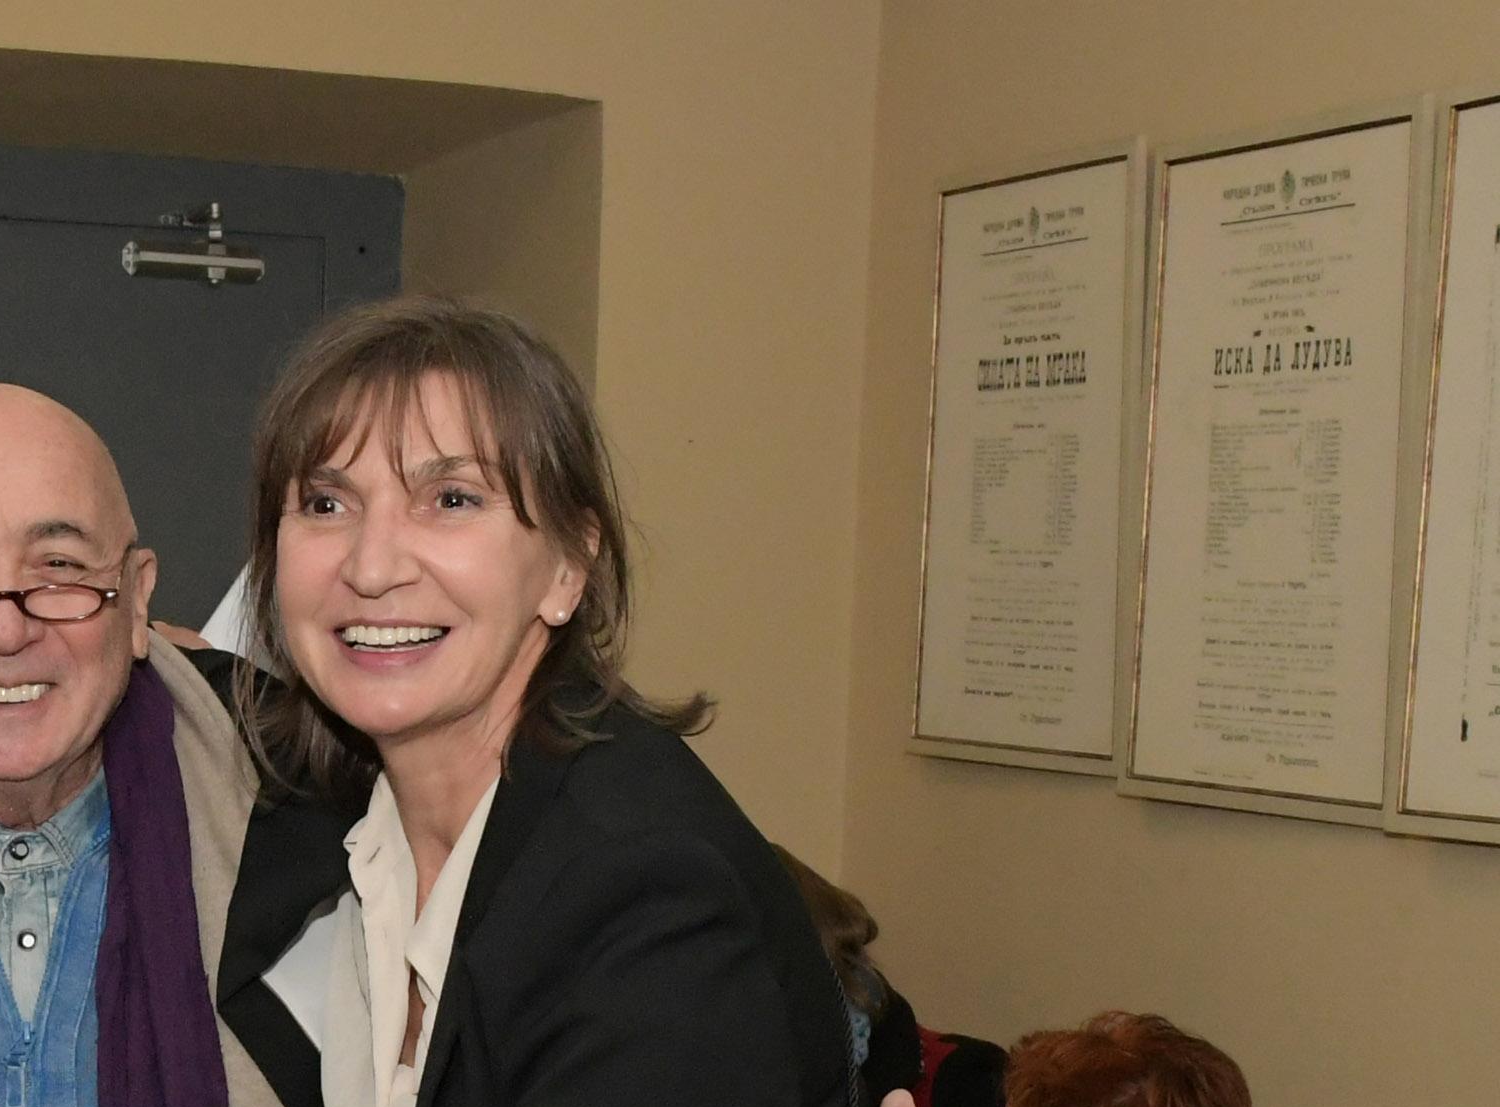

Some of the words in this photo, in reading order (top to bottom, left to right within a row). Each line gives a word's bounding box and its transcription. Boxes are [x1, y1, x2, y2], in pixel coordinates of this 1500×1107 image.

[1213, 345, 1254, 376] ИСКА
[1263, 342, 1282, 376] ДА
[1290, 337, 1353, 371] ЛУДУВА
